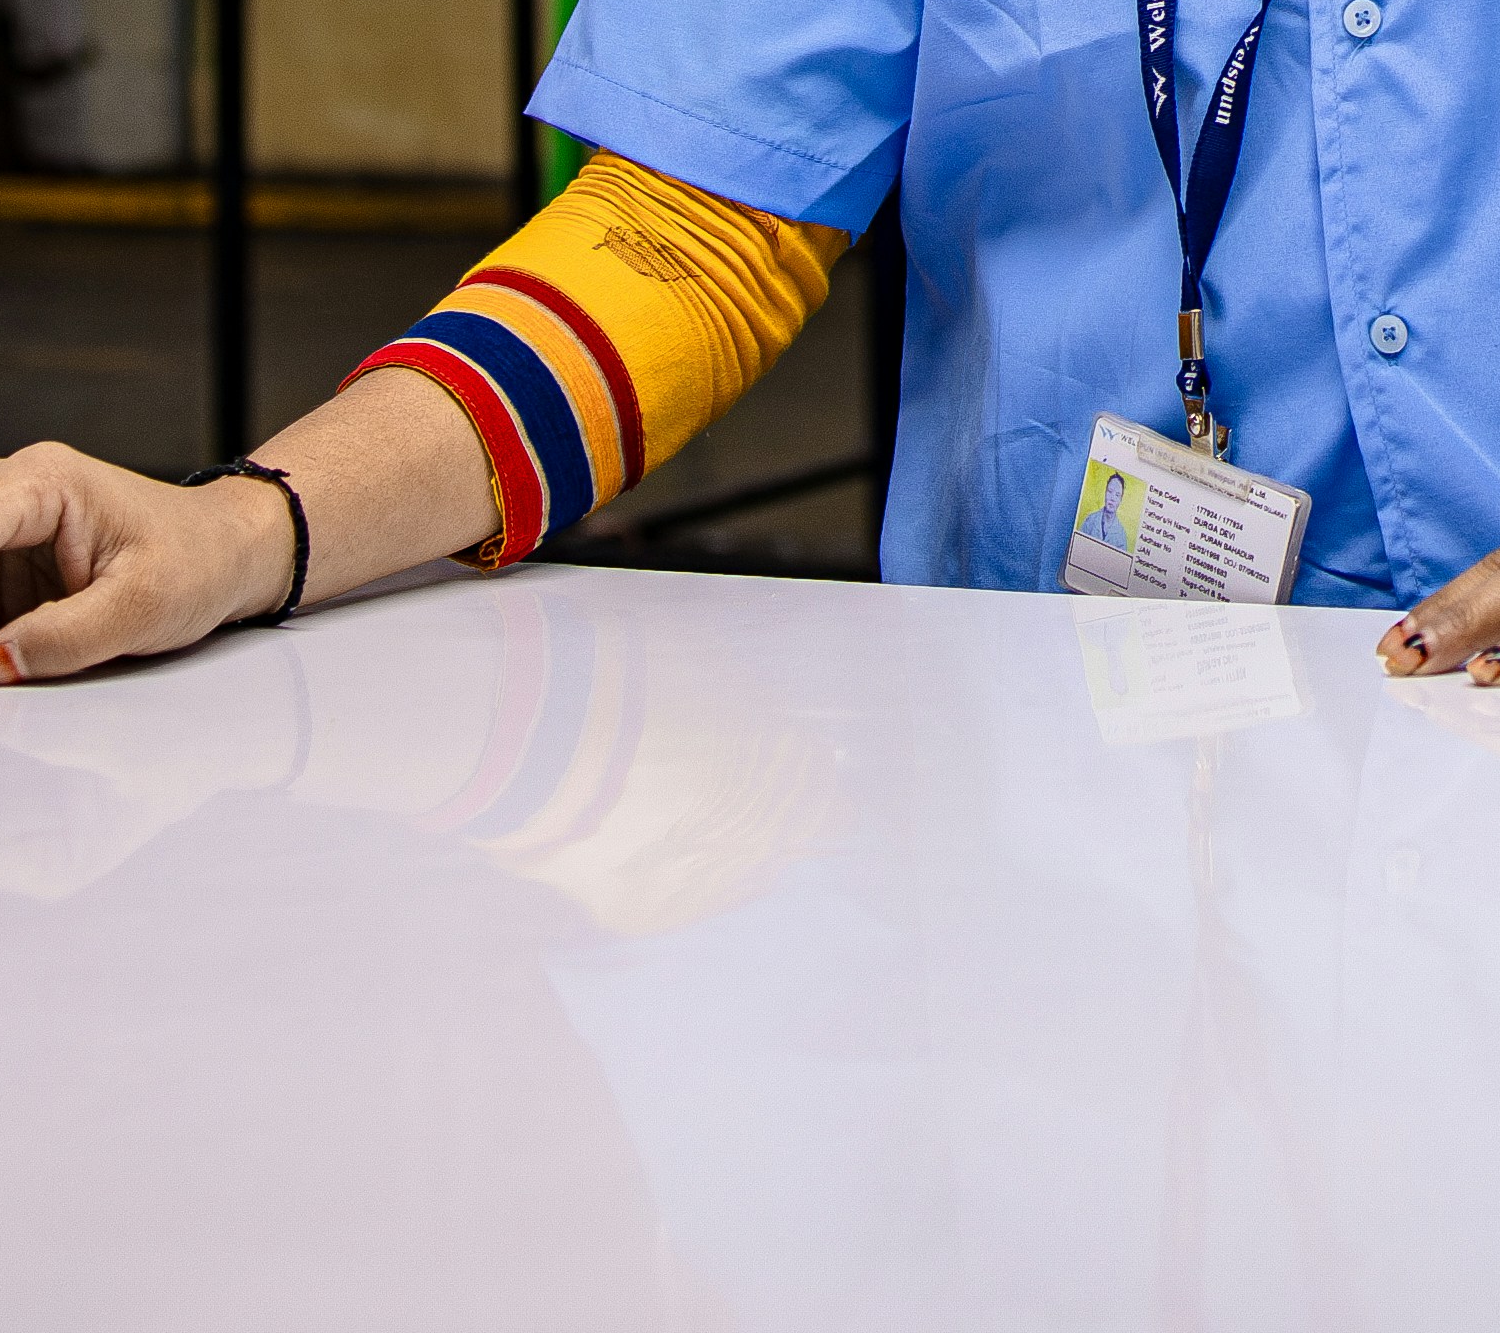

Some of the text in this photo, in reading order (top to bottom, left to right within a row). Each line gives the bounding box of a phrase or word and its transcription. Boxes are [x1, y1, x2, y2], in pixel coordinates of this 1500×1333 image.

[1215, 25, 1260, 125] Welspun
[1200, 532, 1223, 548] PURAN
[1223, 542, 1255, 561] BAHADUR
[1219, 527, 1235, 540] DEVI
